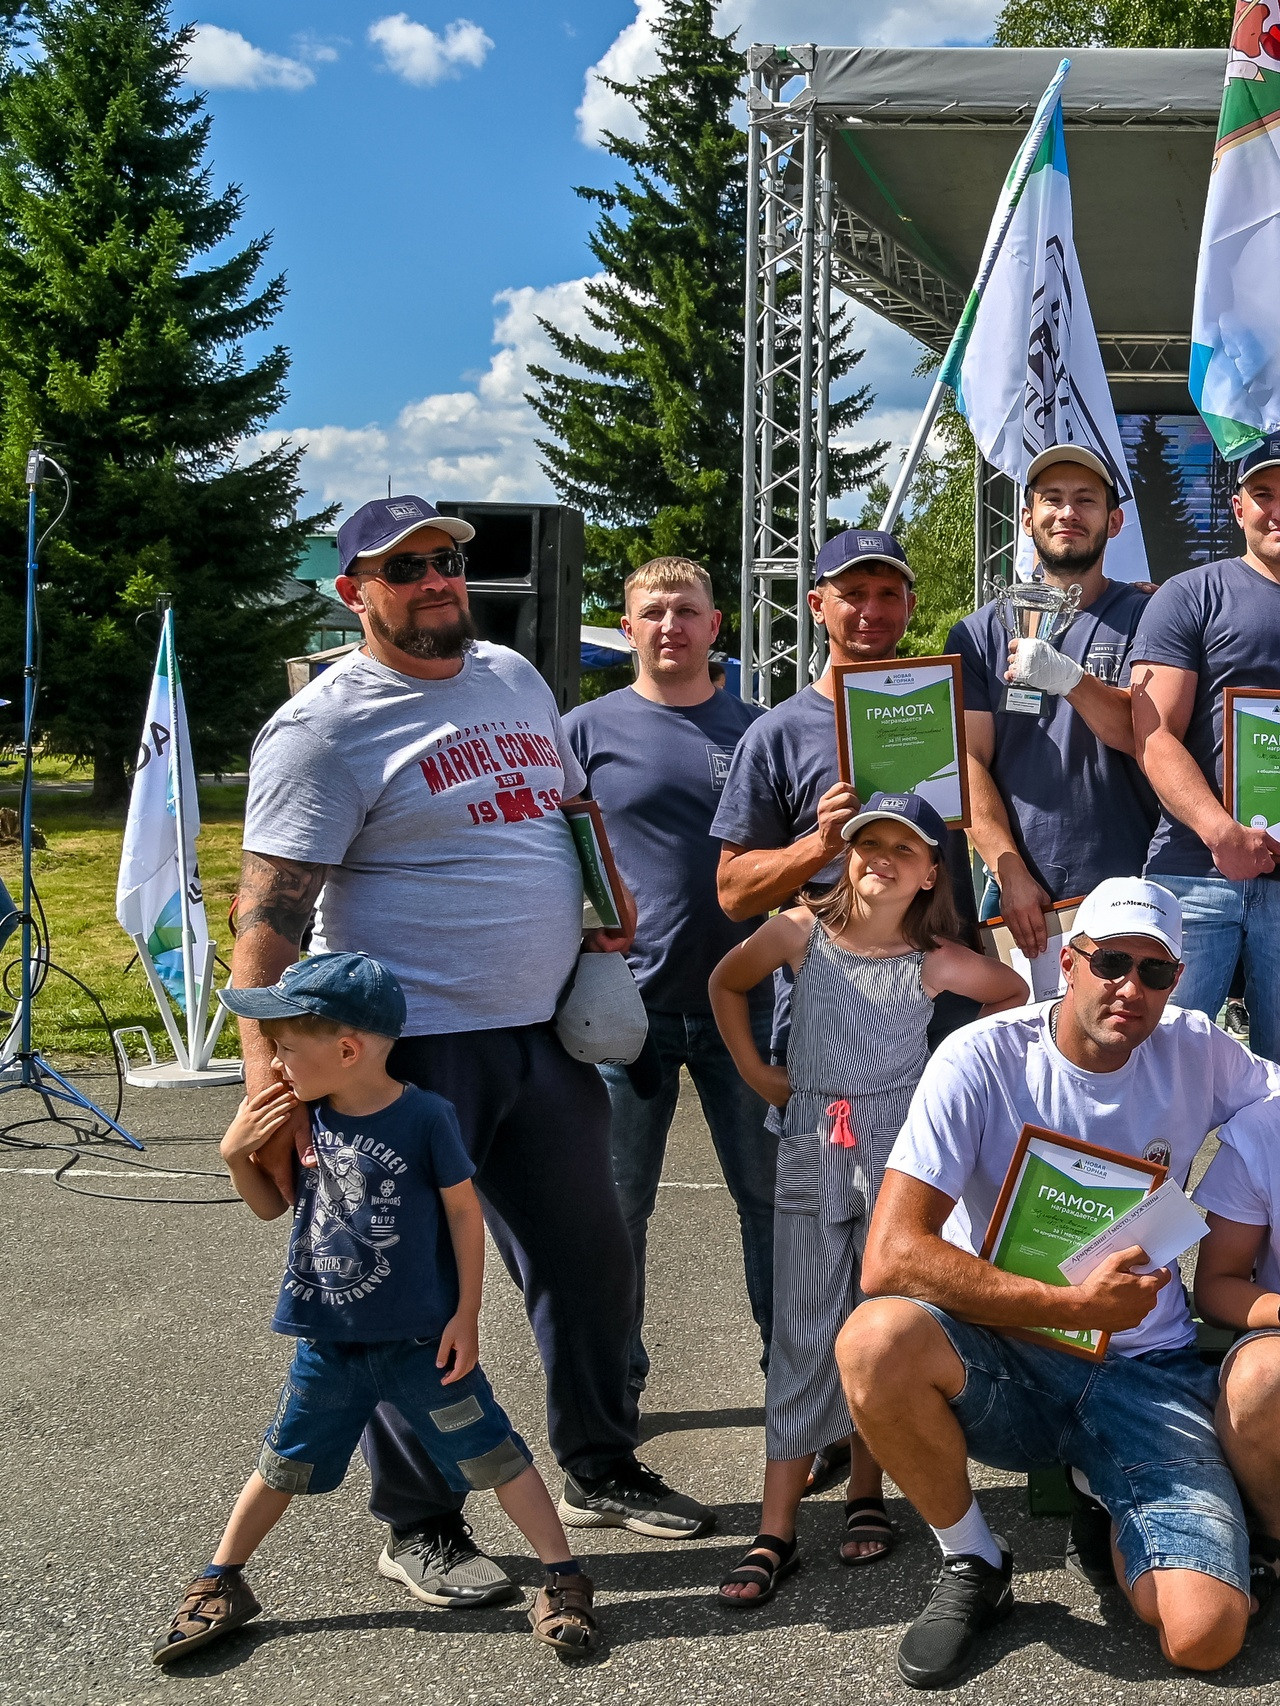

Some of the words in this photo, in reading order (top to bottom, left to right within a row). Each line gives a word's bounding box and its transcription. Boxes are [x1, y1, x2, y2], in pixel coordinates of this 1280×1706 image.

[866, 703, 934, 720] ГРАМОТА
[881, 716, 922, 725] награждается
[436, 722, 507, 748] PROPERTY
[516, 721, 530, 730] OF
[418, 738, 502, 796] MARVEL
[494, 733, 563, 770] COMICS
[503, 774, 518, 785] EST
[582, 836, 605, 906] ГРАМОТА
[318, 1131, 344, 1146] FOR
[351, 1134, 408, 1175] HOCKEY
[1083, 1166, 1107, 1177] ГОРНАЯ
[1084, 1160, 1106, 1170] НОВАЯ
[1038, 1185, 1115, 1220] ГРАМОТА
[1051, 1204, 1098, 1222] награждается
[1131, 1195, 1159, 1220] мужчины
[371, 1216, 395, 1224] GUYS
[284, 1279, 314, 1302] FOR
[321, 1274, 382, 1306] VICTORY
